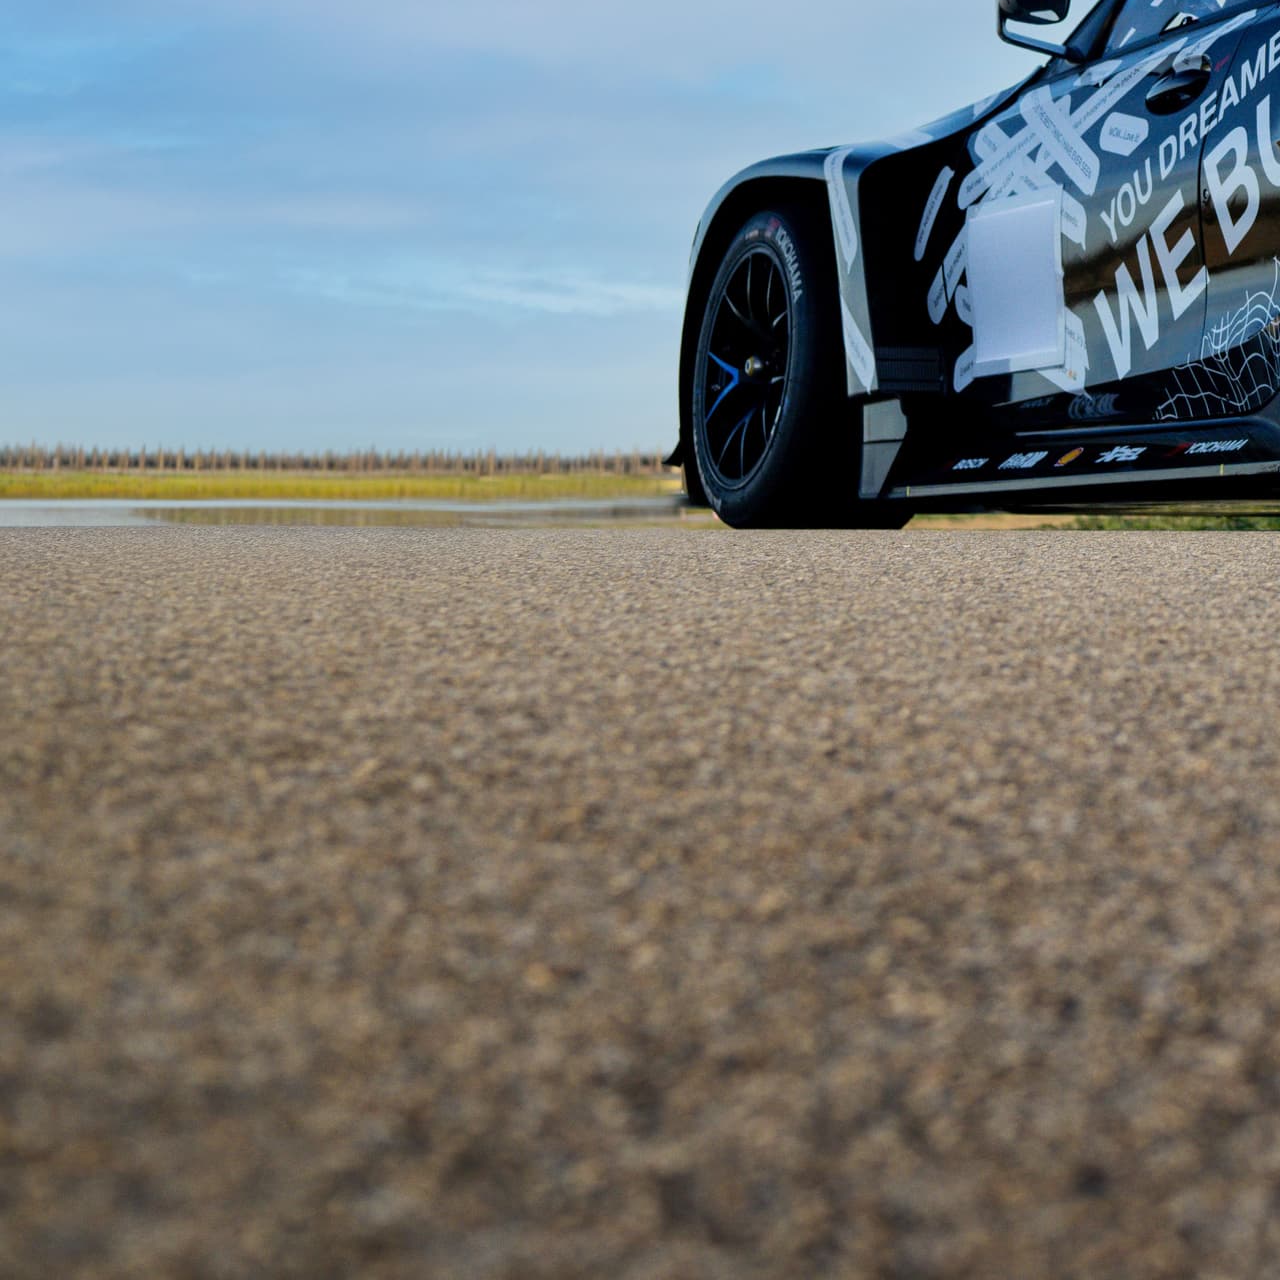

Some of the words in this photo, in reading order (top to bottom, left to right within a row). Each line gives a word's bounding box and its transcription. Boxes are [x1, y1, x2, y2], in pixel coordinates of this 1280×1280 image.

[1100, 157, 1153, 243] YOU
[775, 225, 802, 304] YOKOHAMA
[1093, 189, 1210, 380] WE
